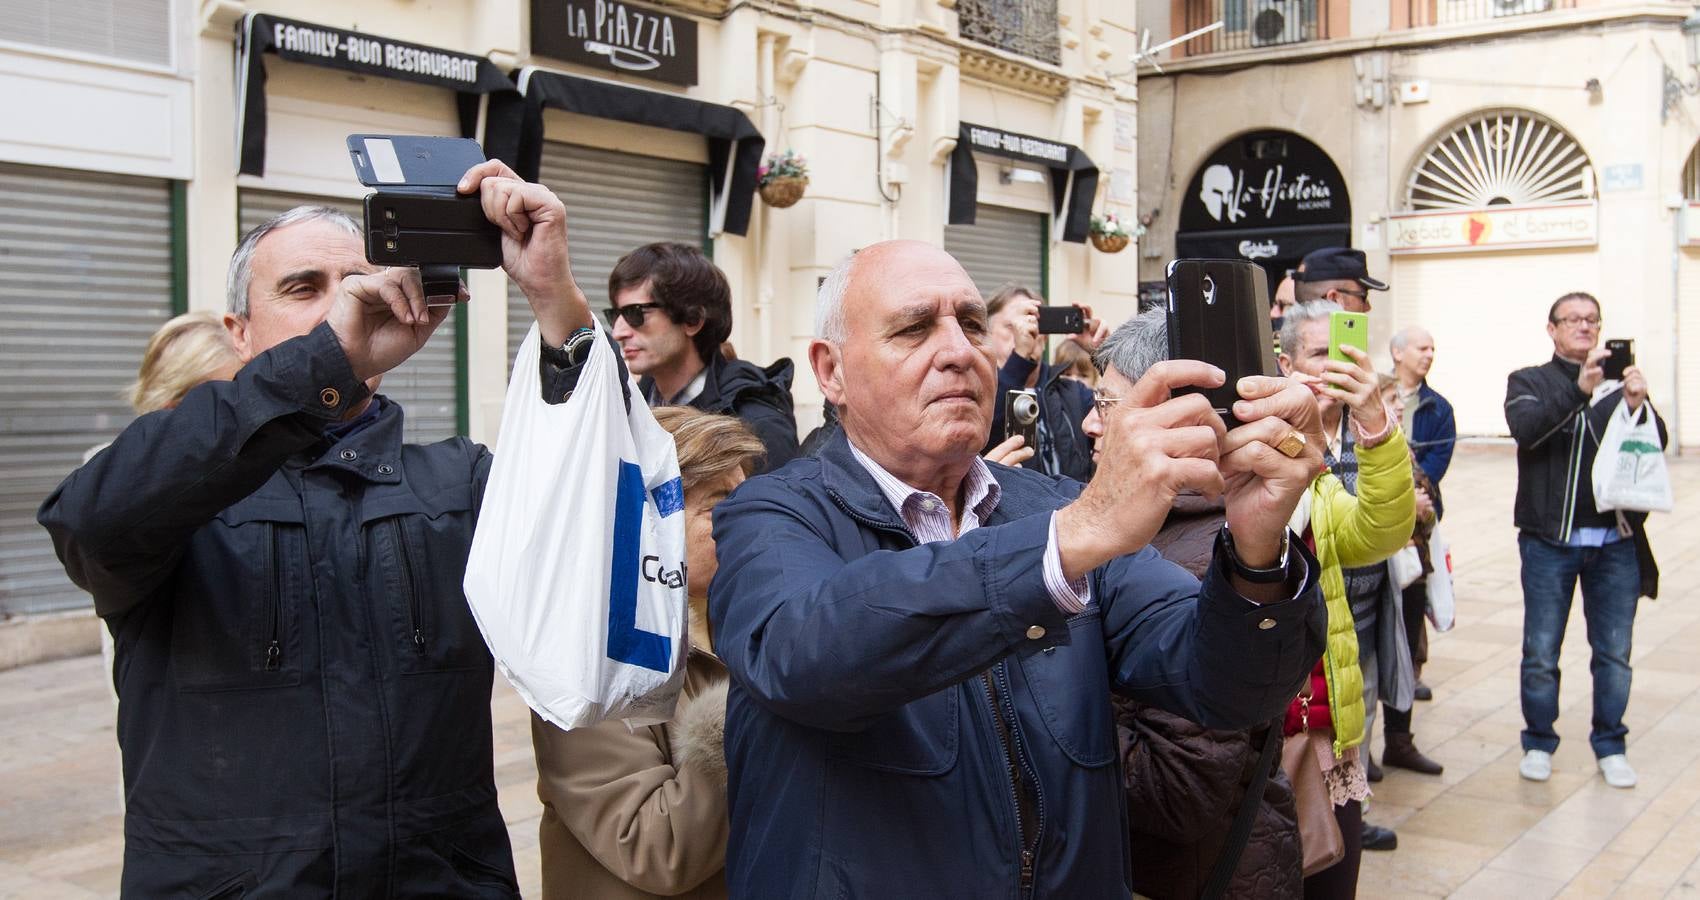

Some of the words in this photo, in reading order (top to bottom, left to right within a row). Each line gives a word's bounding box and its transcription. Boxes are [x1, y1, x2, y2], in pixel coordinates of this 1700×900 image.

[567, 3, 588, 38] LA
[274, 22, 382, 66] FAMILY-RUN
[385, 43, 478, 83] RESTAURANT
[1228, 169, 1252, 223] La
[1248, 164, 1330, 219] Historia
